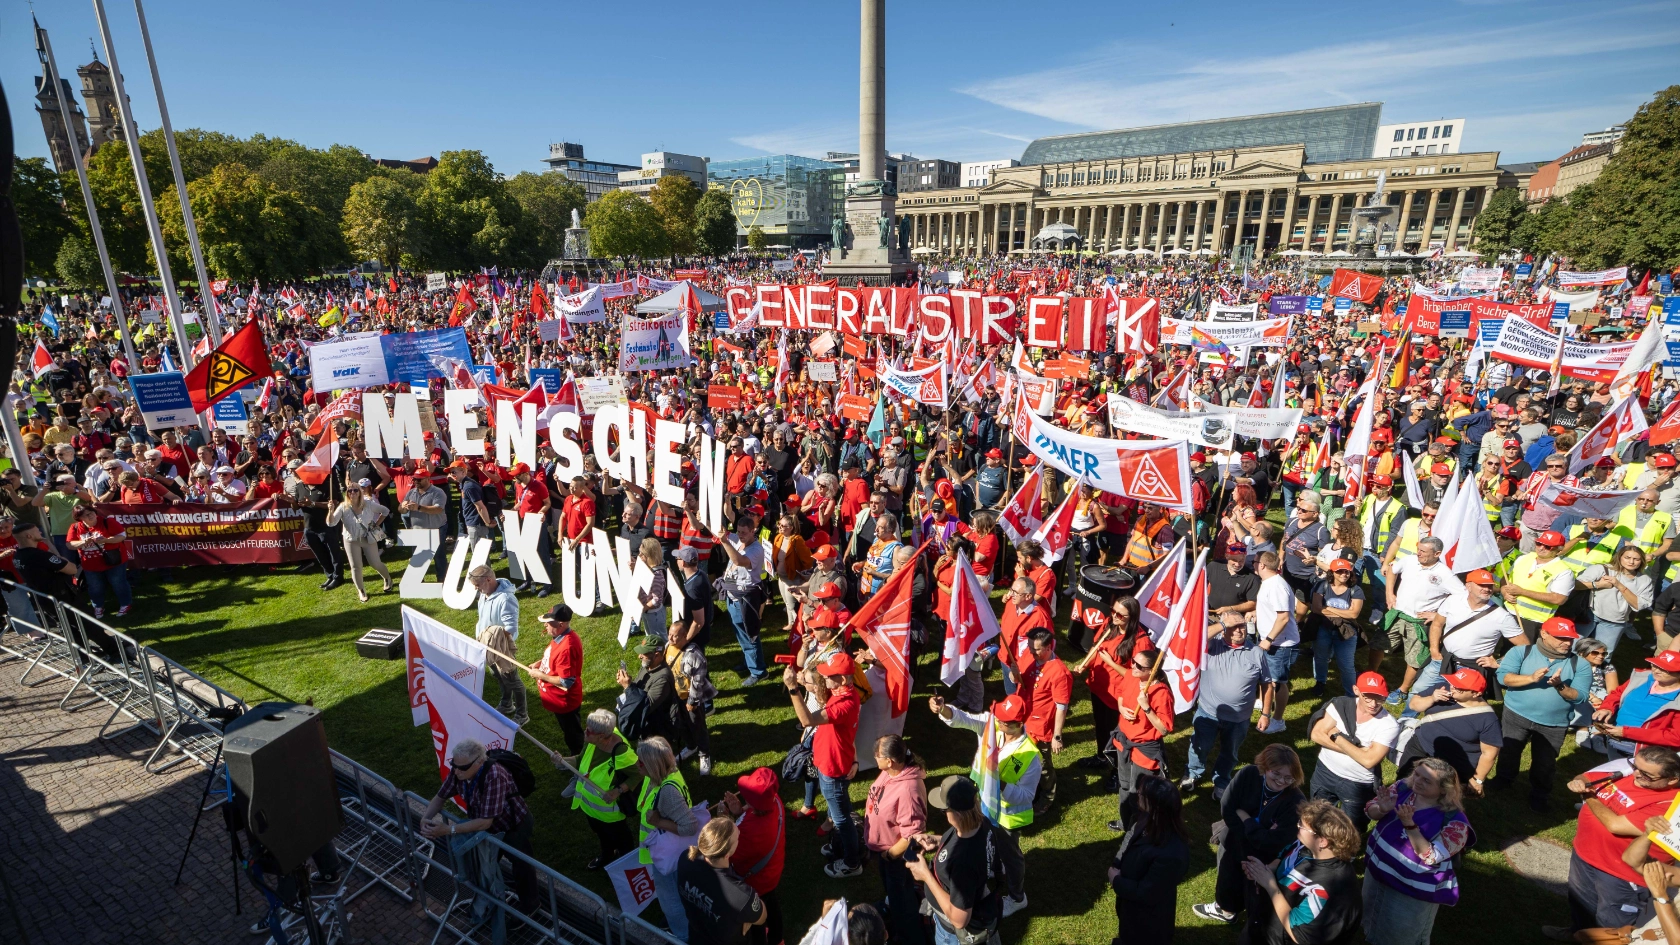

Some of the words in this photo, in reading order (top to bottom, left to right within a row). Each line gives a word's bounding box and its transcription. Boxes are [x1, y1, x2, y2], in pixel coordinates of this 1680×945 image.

[739, 189, 753, 197] Das
[737, 197, 756, 207] kalte
[738, 207, 755, 216] Herz
[725, 284, 1158, 353] GENERALSTREIK
[1503, 333, 1520, 344] VON
[1500, 340, 1550, 360] MONOPOLEN
[333, 366, 361, 378] VdK
[363, 388, 726, 538] MENSCHEN
[147, 511, 217, 524] KÜRZUNGEN
[219, 511, 234, 521] IM
[235, 507, 304, 521] SOZIALSTAA
[161, 524, 207, 537] RECHTE,
[207, 523, 253, 536] UNSERE
[136, 540, 218, 554] VERTRAUENSLEUTE
[219, 539, 245, 550] BOSCH
[246, 538, 291, 549] FEUERBACH
[1085, 608, 1105, 625] VL
[1662, 835, 1675, 846] Mit
[684, 881, 714, 911] MKS
